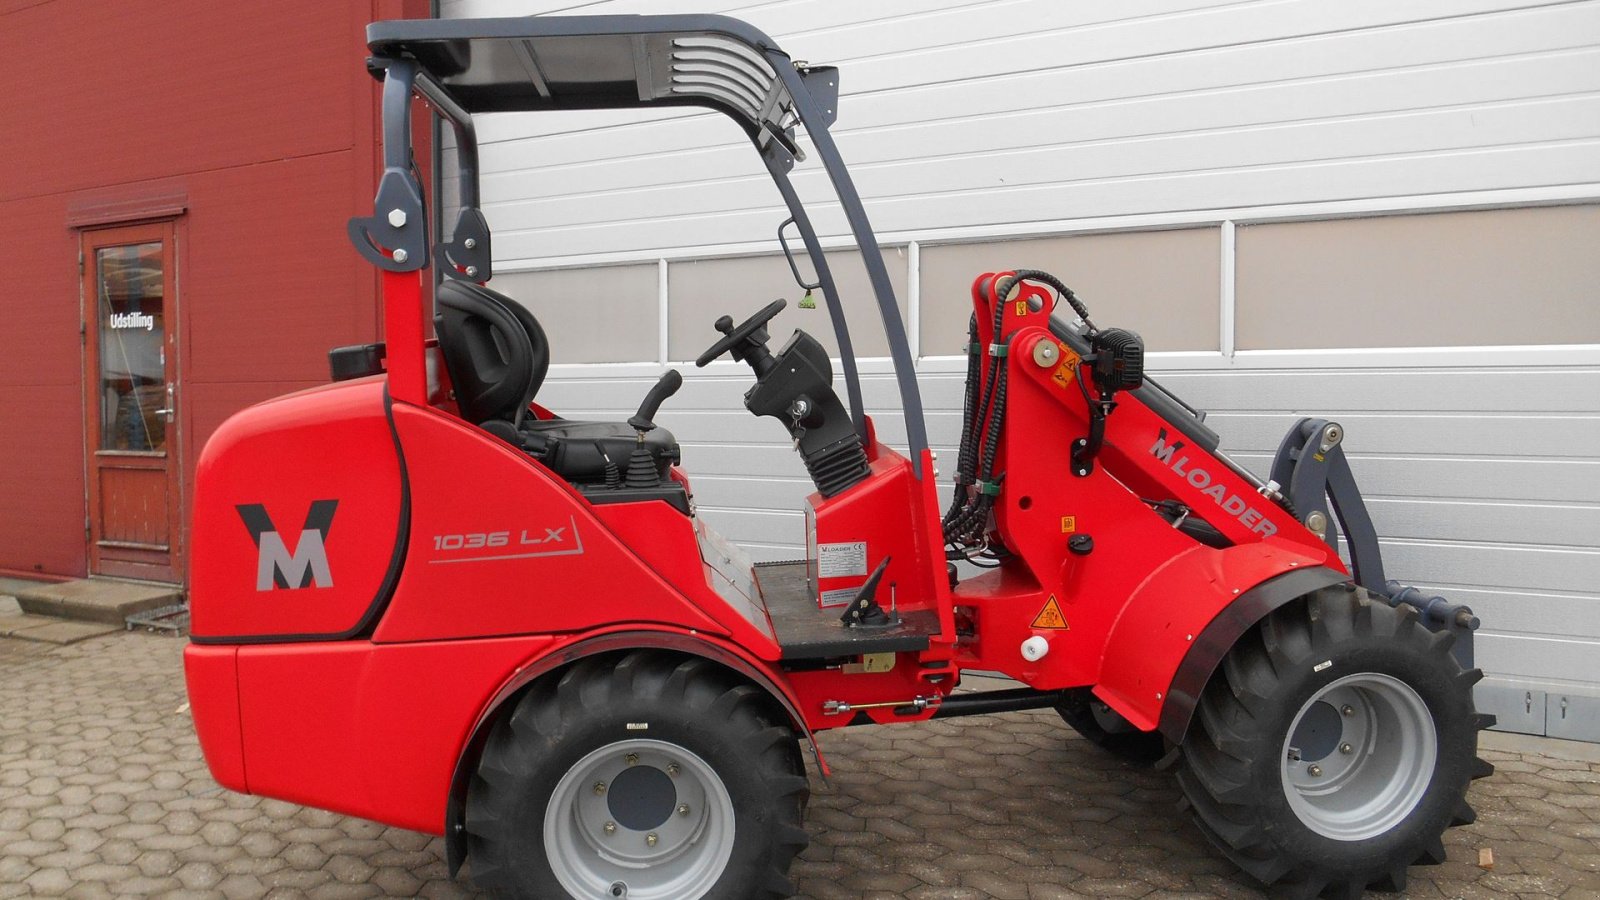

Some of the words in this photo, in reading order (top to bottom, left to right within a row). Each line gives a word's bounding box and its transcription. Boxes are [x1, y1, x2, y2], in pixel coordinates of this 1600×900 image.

[110, 311, 153, 331] Udstilling
[1171, 456, 1278, 539] LOADER
[433, 531, 510, 550] 1036
[520, 527, 566, 545] LX
